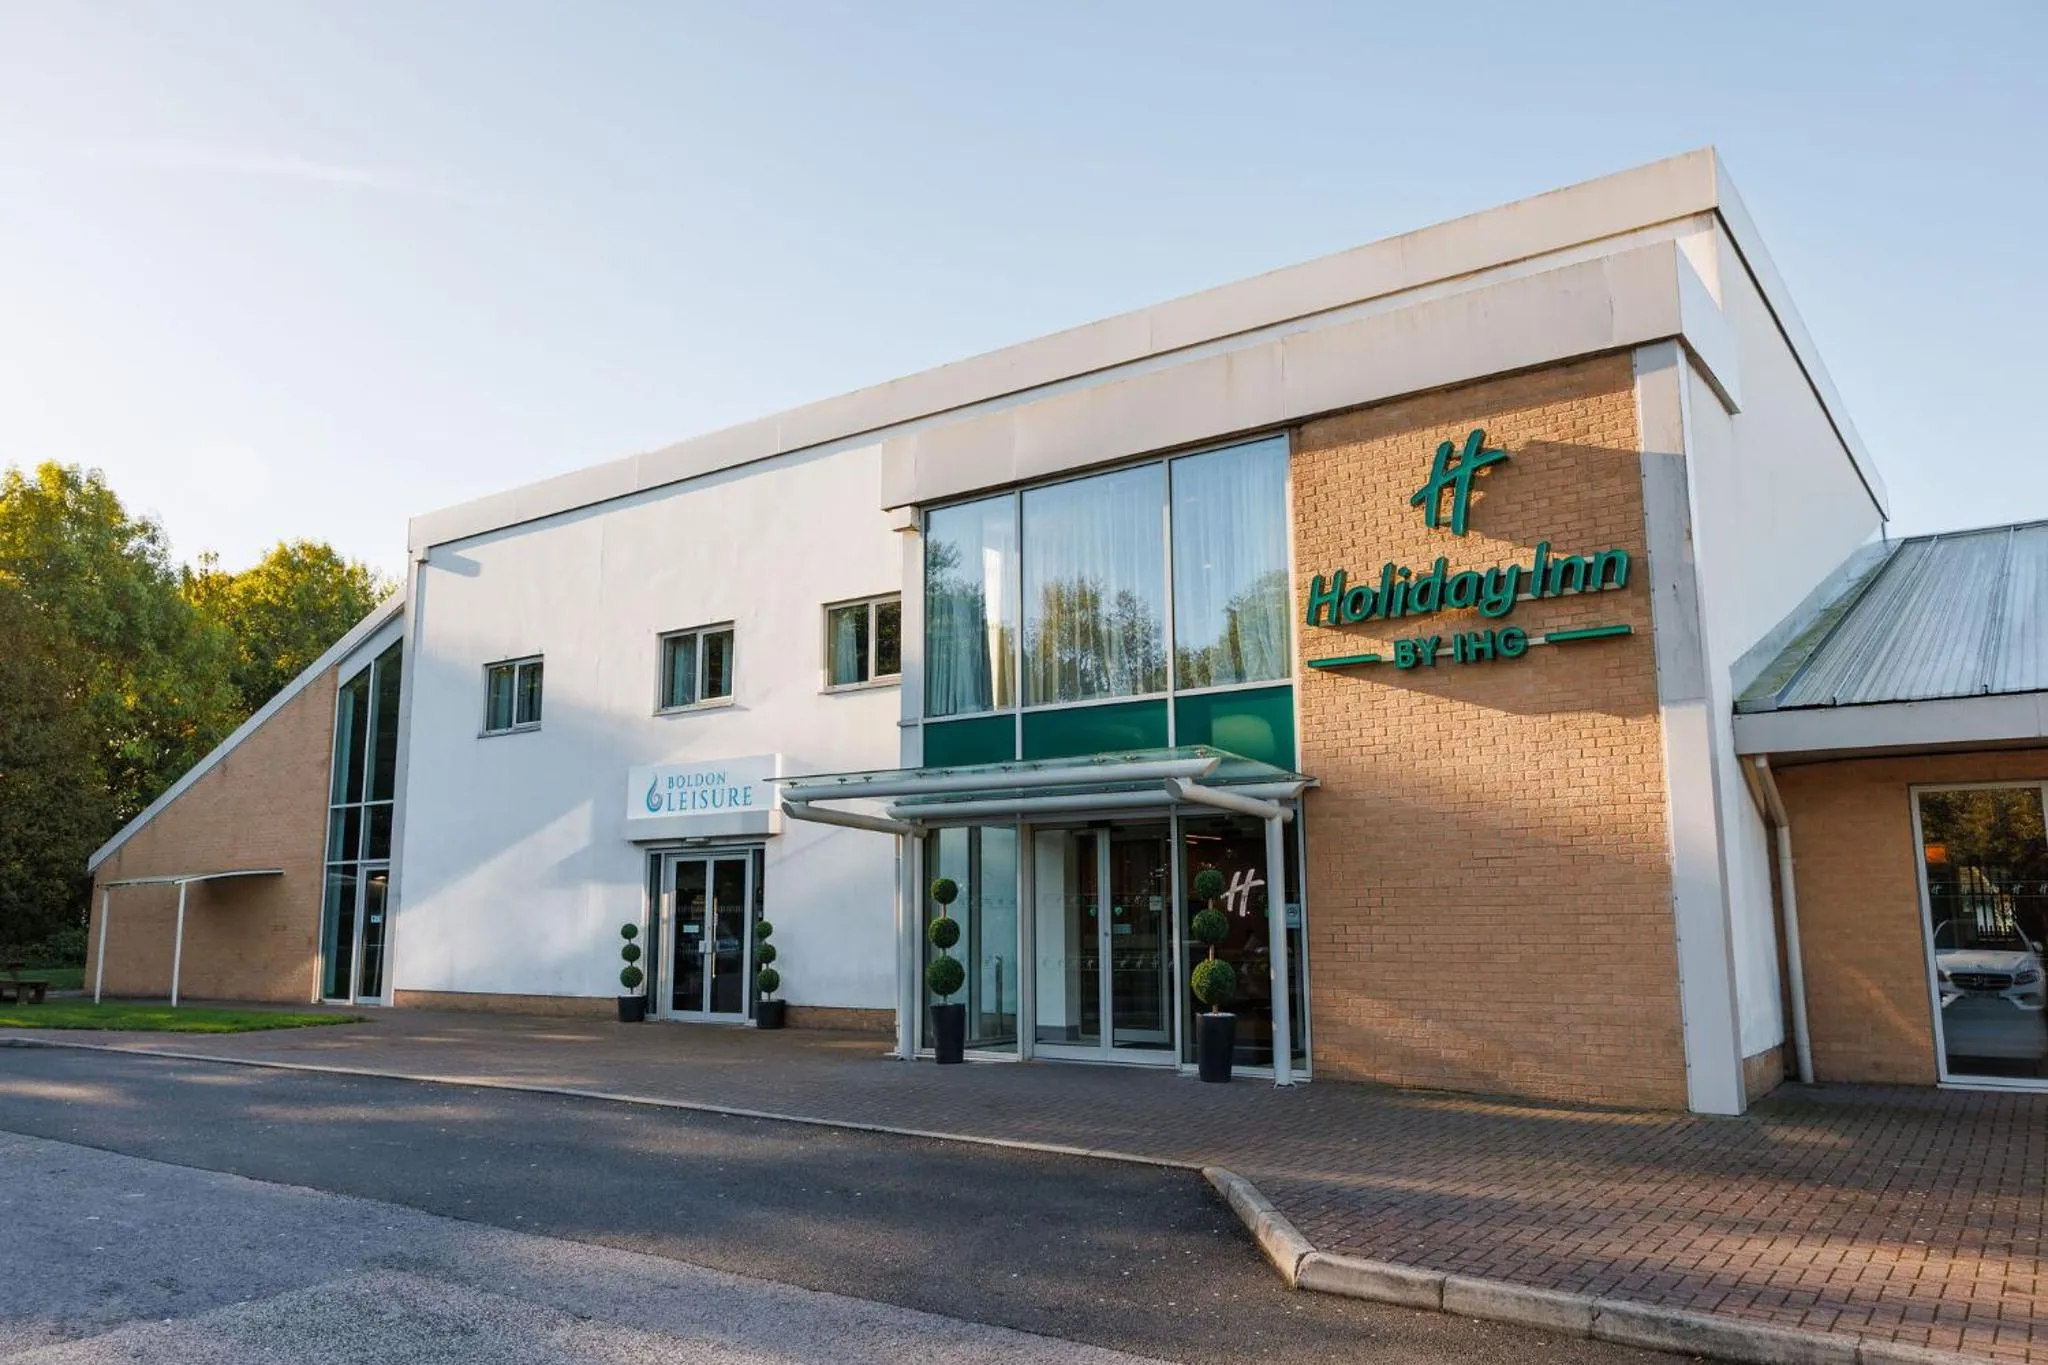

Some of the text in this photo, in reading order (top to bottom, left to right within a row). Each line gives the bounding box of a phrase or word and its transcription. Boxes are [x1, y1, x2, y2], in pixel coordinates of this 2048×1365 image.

[1410, 428, 1510, 536] H
[1307, 540, 1631, 626] Holiday Inn
[1394, 626, 1529, 670] BY IHG
[666, 785, 752, 812] LEISURE
[668, 771, 726, 789] BOLDON
